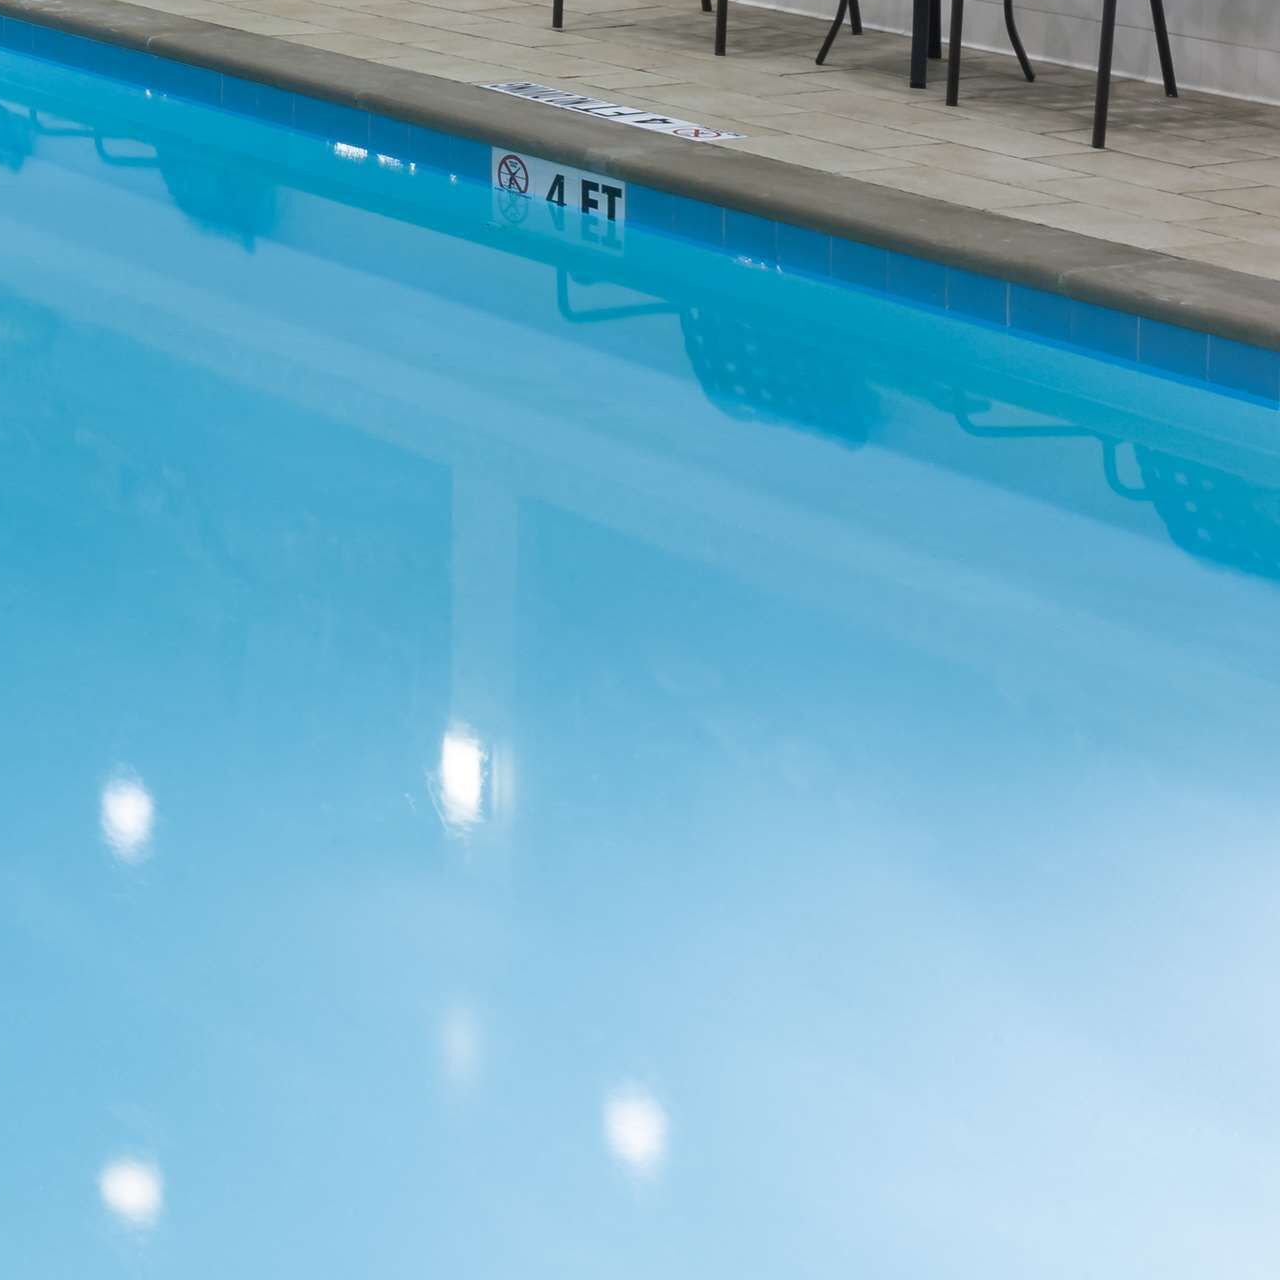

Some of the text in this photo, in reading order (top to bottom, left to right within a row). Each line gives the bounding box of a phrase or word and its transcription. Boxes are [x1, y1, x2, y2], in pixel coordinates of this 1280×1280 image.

[570, 105, 648, 117] FT
[546, 174, 622, 222] 4 FT
